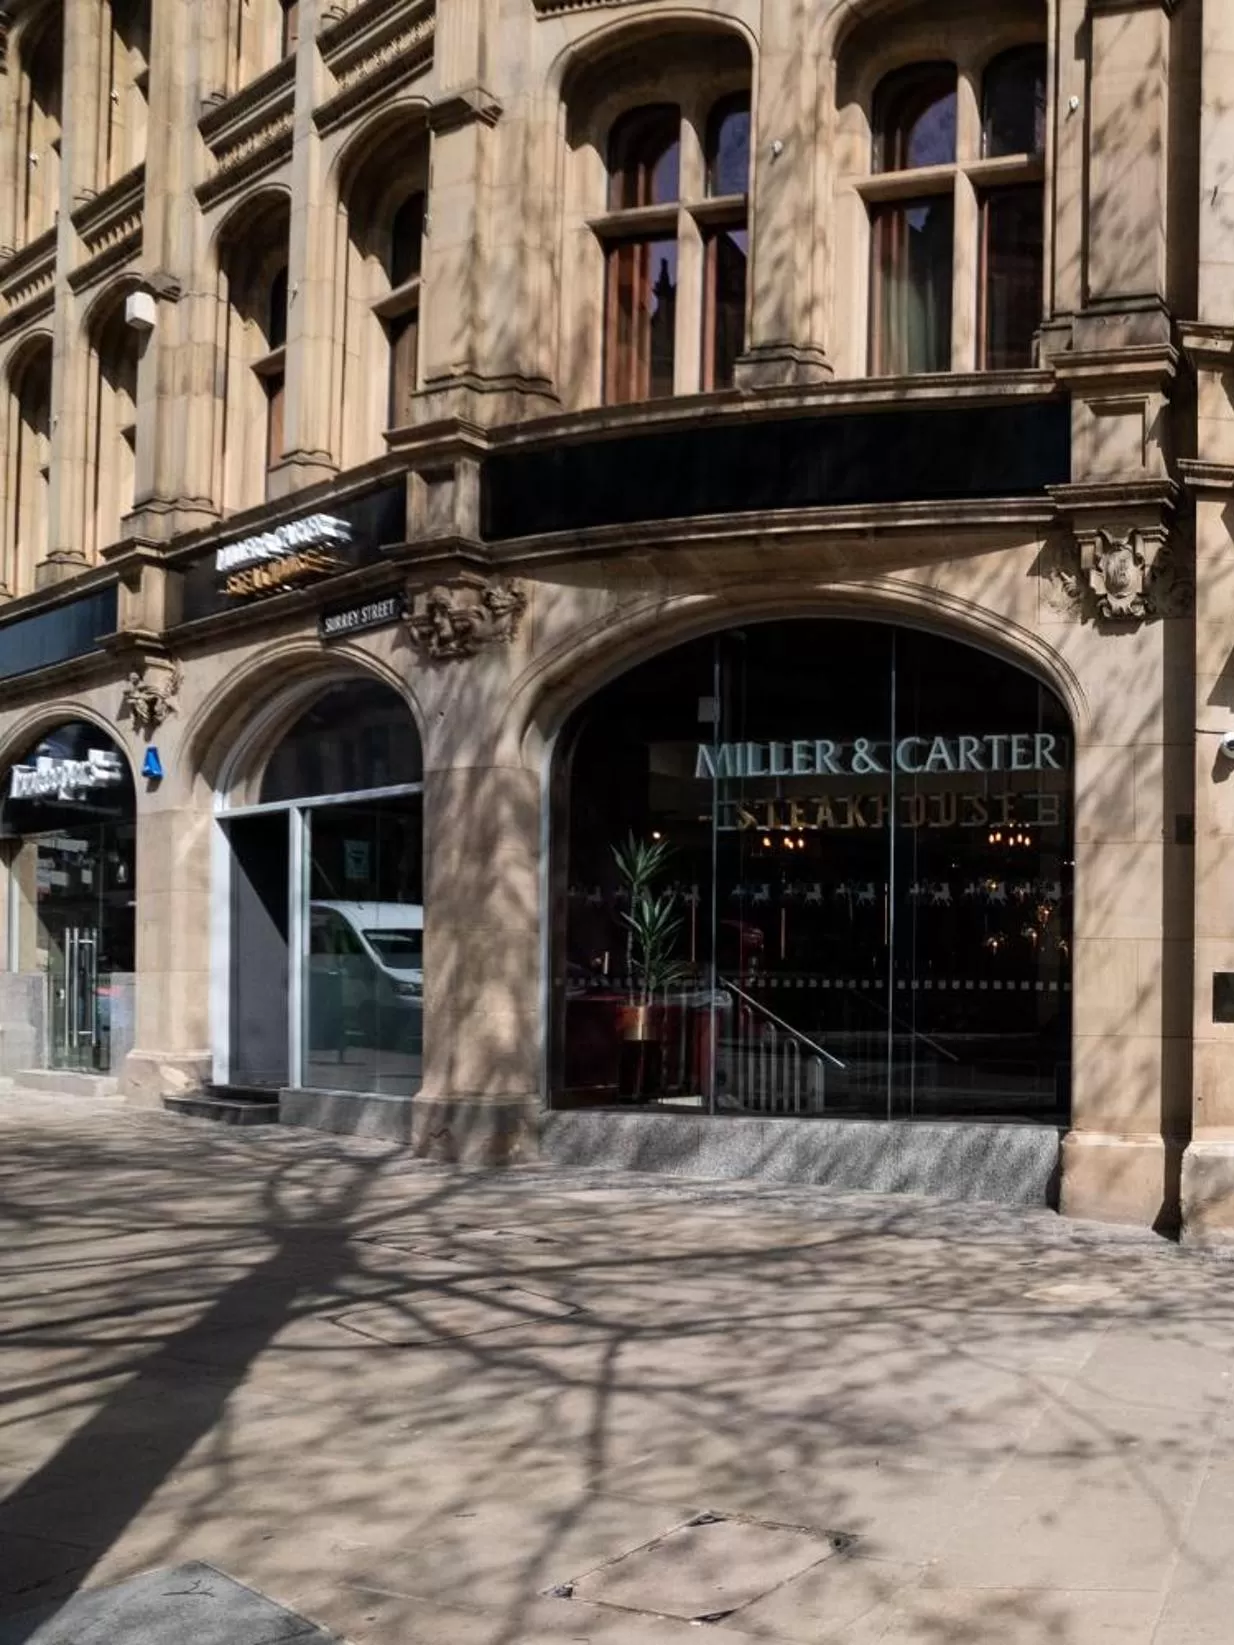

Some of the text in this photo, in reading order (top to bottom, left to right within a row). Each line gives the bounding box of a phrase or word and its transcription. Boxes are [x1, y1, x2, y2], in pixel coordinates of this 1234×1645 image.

[361, 598, 395, 623] STREET
[695, 733, 1061, 779] MILLER & CARTER
[737, 792, 1019, 830] STEAKHOUSE
